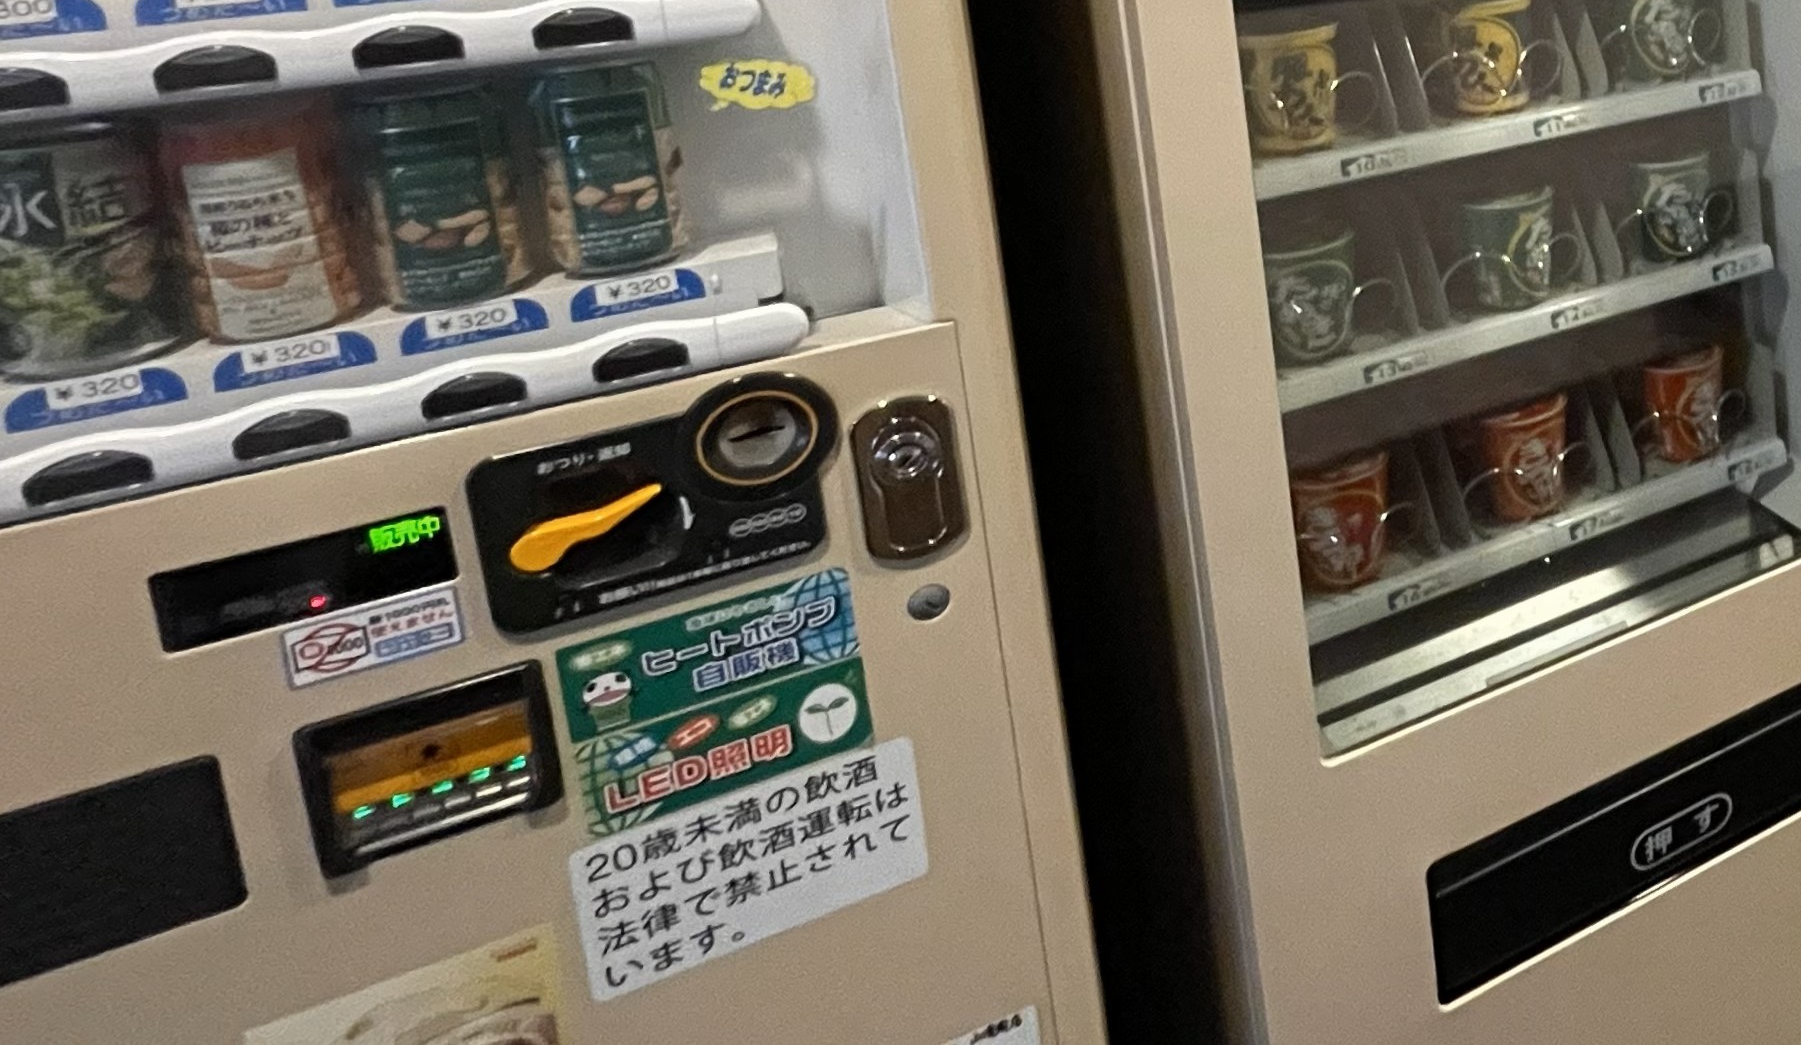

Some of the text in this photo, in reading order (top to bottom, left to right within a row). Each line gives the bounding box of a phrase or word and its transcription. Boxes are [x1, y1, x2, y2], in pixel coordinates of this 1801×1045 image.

[719, 63, 787, 99] おつまみ
[607, 274, 672, 299] ¥320
[436, 308, 507, 332] ¥320
[251, 338, 327, 367] ¥320
[55, 372, 141, 402] ¥320
[369, 609, 454, 638] 使えません
[693, 636, 800, 693] 自販機
[603, 723, 793, 815] LED照明
[586, 754, 878, 885] 20歳未満の飲酒
[1644, 803, 1720, 864] 押す
[592, 782, 909, 918] および飲酒運転は
[598, 813, 911, 958] 法律で禁止されて
[606, 923, 746, 988] います。
